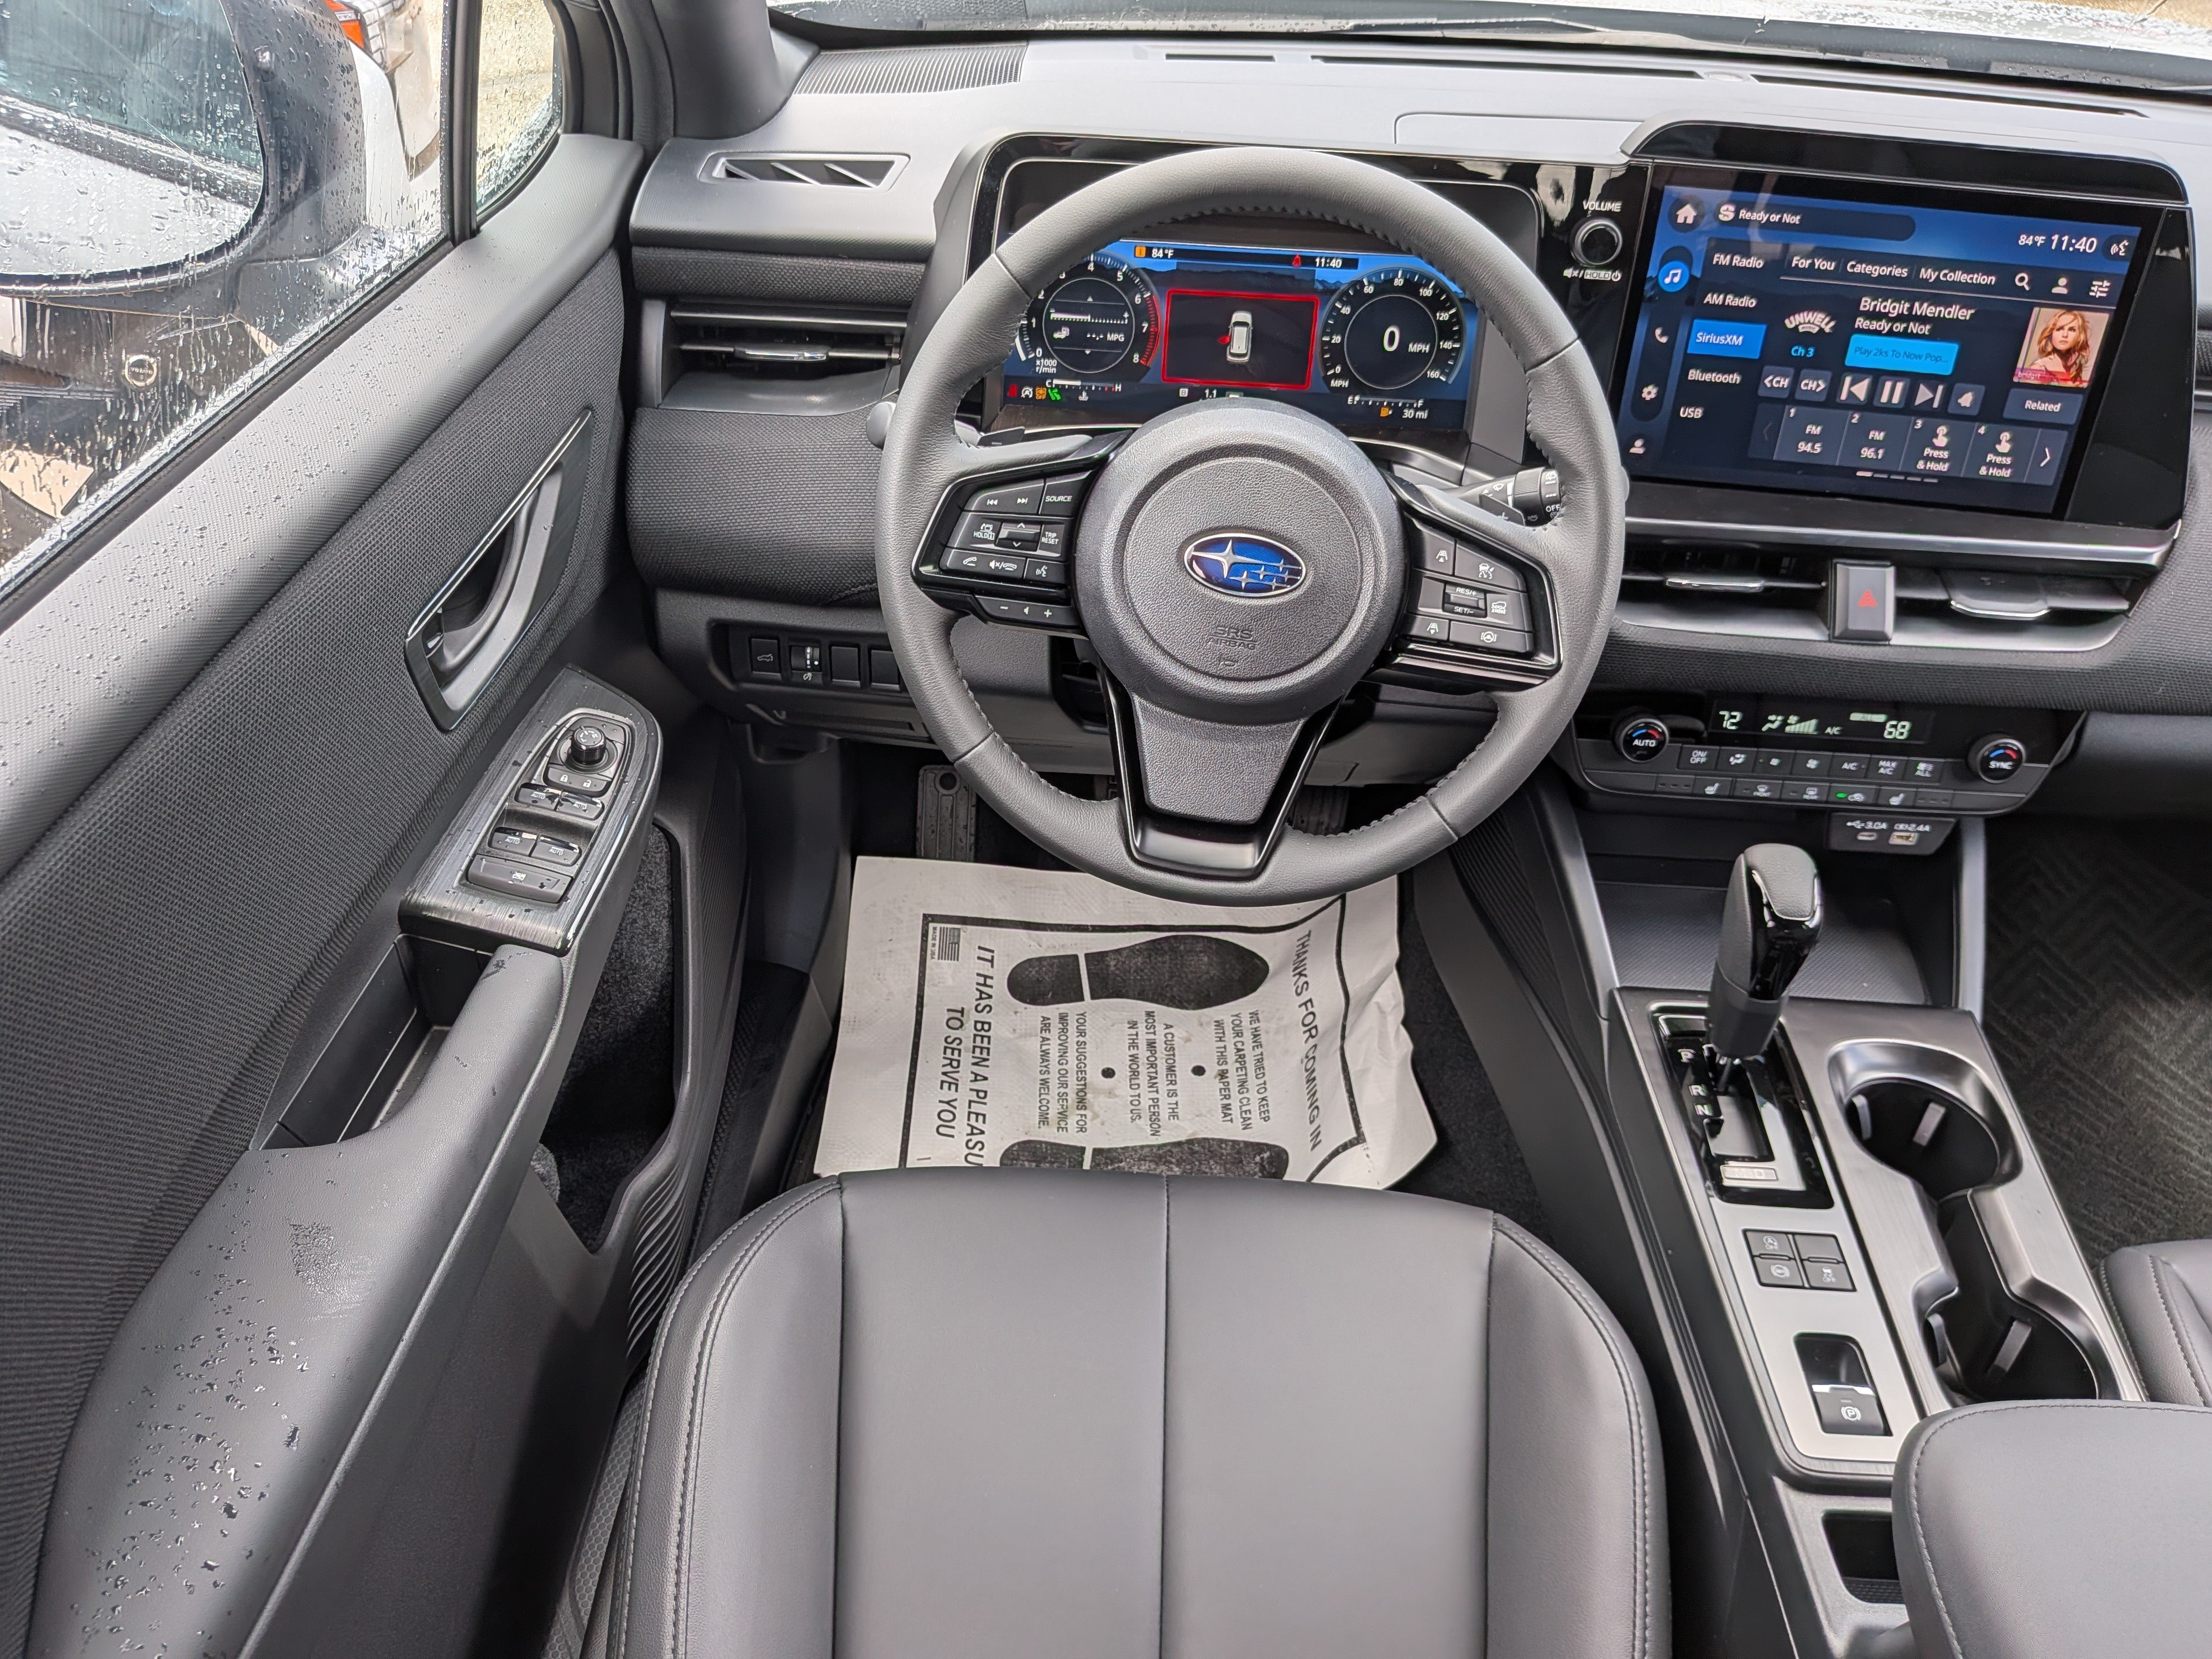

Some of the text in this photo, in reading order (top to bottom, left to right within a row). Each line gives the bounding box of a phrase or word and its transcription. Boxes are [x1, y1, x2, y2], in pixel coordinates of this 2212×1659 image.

[1583, 200, 1622, 212] VOLUME
[1739, 209, 1801, 224] Ready or Not
[2018, 234, 2098, 253] 84°F 11:40
[1087, 262, 1094, 272] 4
[1315, 257, 1342, 268] 11:40
[1713, 254, 1764, 269] FM Radio
[1792, 256, 1835, 271] For You
[1847, 260, 1908, 278] Categories
[1117, 272, 1123, 281] 5
[1394, 278, 1404, 286] 80
[1920, 268, 1996, 285] My Collection
[1038, 289, 1044, 299] 2
[1364, 285, 1374, 294] 60
[1419, 288, 1432, 297] 100
[1135, 295, 1141, 305] 6
[1704, 293, 1757, 308] AM Radio
[1340, 306, 1350, 315] 40
[1860, 297, 1975, 321] Bridgit Mendler
[1436, 312, 1449, 321] 120
[1784, 310, 1837, 333] UNWELL
[1141, 321, 1149, 333] 7
[1855, 317, 1931, 335] Ready or Not
[1107, 332, 1125, 342] MPG
[1332, 335, 1341, 344] 20
[1384, 326, 1400, 352] 0
[1695, 332, 1743, 346] SiriusXM
[1408, 343, 1430, 353] MPH
[1439, 341, 1452, 350] 140
[1791, 346, 1815, 357] Ch 3
[1036, 347, 1042, 357] 0
[1133, 353, 1139, 363] 8
[1854, 347, 1872, 358] Play
[1891, 349, 1901, 359] To
[1902, 351, 1923, 360] Now
[1036, 358, 1057, 367] x1000
[1335, 365, 1341, 374] 0
[1427, 371, 1439, 379] 160
[1688, 369, 1741, 384] Bluetooth
[1331, 379, 1349, 388] MPH
[1790, 408, 1795, 417] 1
[2025, 400, 2061, 413] Related
[1402, 409, 1428, 419] 30 mi
[1679, 407, 1703, 419] USB
[1851, 414, 1859, 423] 2
[1806, 425, 1822, 435] FM
[1914, 420, 1923, 429] 3
[1978, 426, 1985, 435] 4
[1869, 431, 1885, 440] FM
[1797, 443, 1822, 454] 94.5
[1860, 448, 1884, 460] 96.1
[1924, 447, 1949, 459] Press
[1986, 453, 2011, 465] Press
[1917, 461, 1949, 472] & Hold
[1979, 466, 2011, 478] & Hold
[1546, 504, 1560, 512] OFF
[1215, 626, 1253, 640] SRS
[1207, 638, 1257, 650] AIRBAG
[1719, 711, 1743, 729] 72
[1825, 726, 1843, 735] A/C
[1884, 721, 1911, 739] 68
[1632, 738, 1657, 747] AUTO
[1989, 761, 2013, 770] SYNC
[977, 945, 995, 969] IT
[974, 972, 994, 1014] HAS
[971, 1020, 992, 1068] BEEN
[1292, 930, 1322, 1152] THANKS FOR COMING IN
[1164, 1032, 1177, 1086] CUSTOMER
[1681, 1051, 1694, 1063] P
[936, 1006, 965, 1139] TO SERVE YOU
[1038, 1015, 1051, 1129] ARE ALWAYS WELCOME.
[1057, 1012, 1069, 1133] IMPROVING OUR SERVICE
[1076, 1011, 1087, 1133] YOUR SUGGESTIONS FOR
[1127, 1020, 1141, 1123] IN THE WORLD TO US.
[1213, 1019, 1234, 1124] WITH THIS PAPER MAT
[1230, 1013, 1253, 1131] YOUR CARPETING CLEAN
[1249, 1010, 1271, 1123] WE HAVE TRIED TO KEEP
[969, 1071, 989, 1083] A
[1145, 1010, 1161, 1137] MOST IMPORTANT PERSON
[1166, 1089, 1178, 1098] IS
[1690, 1085, 1707, 1096] R
[1167, 1100, 1180, 1121] THE
[1694, 1104, 1713, 1115] N
